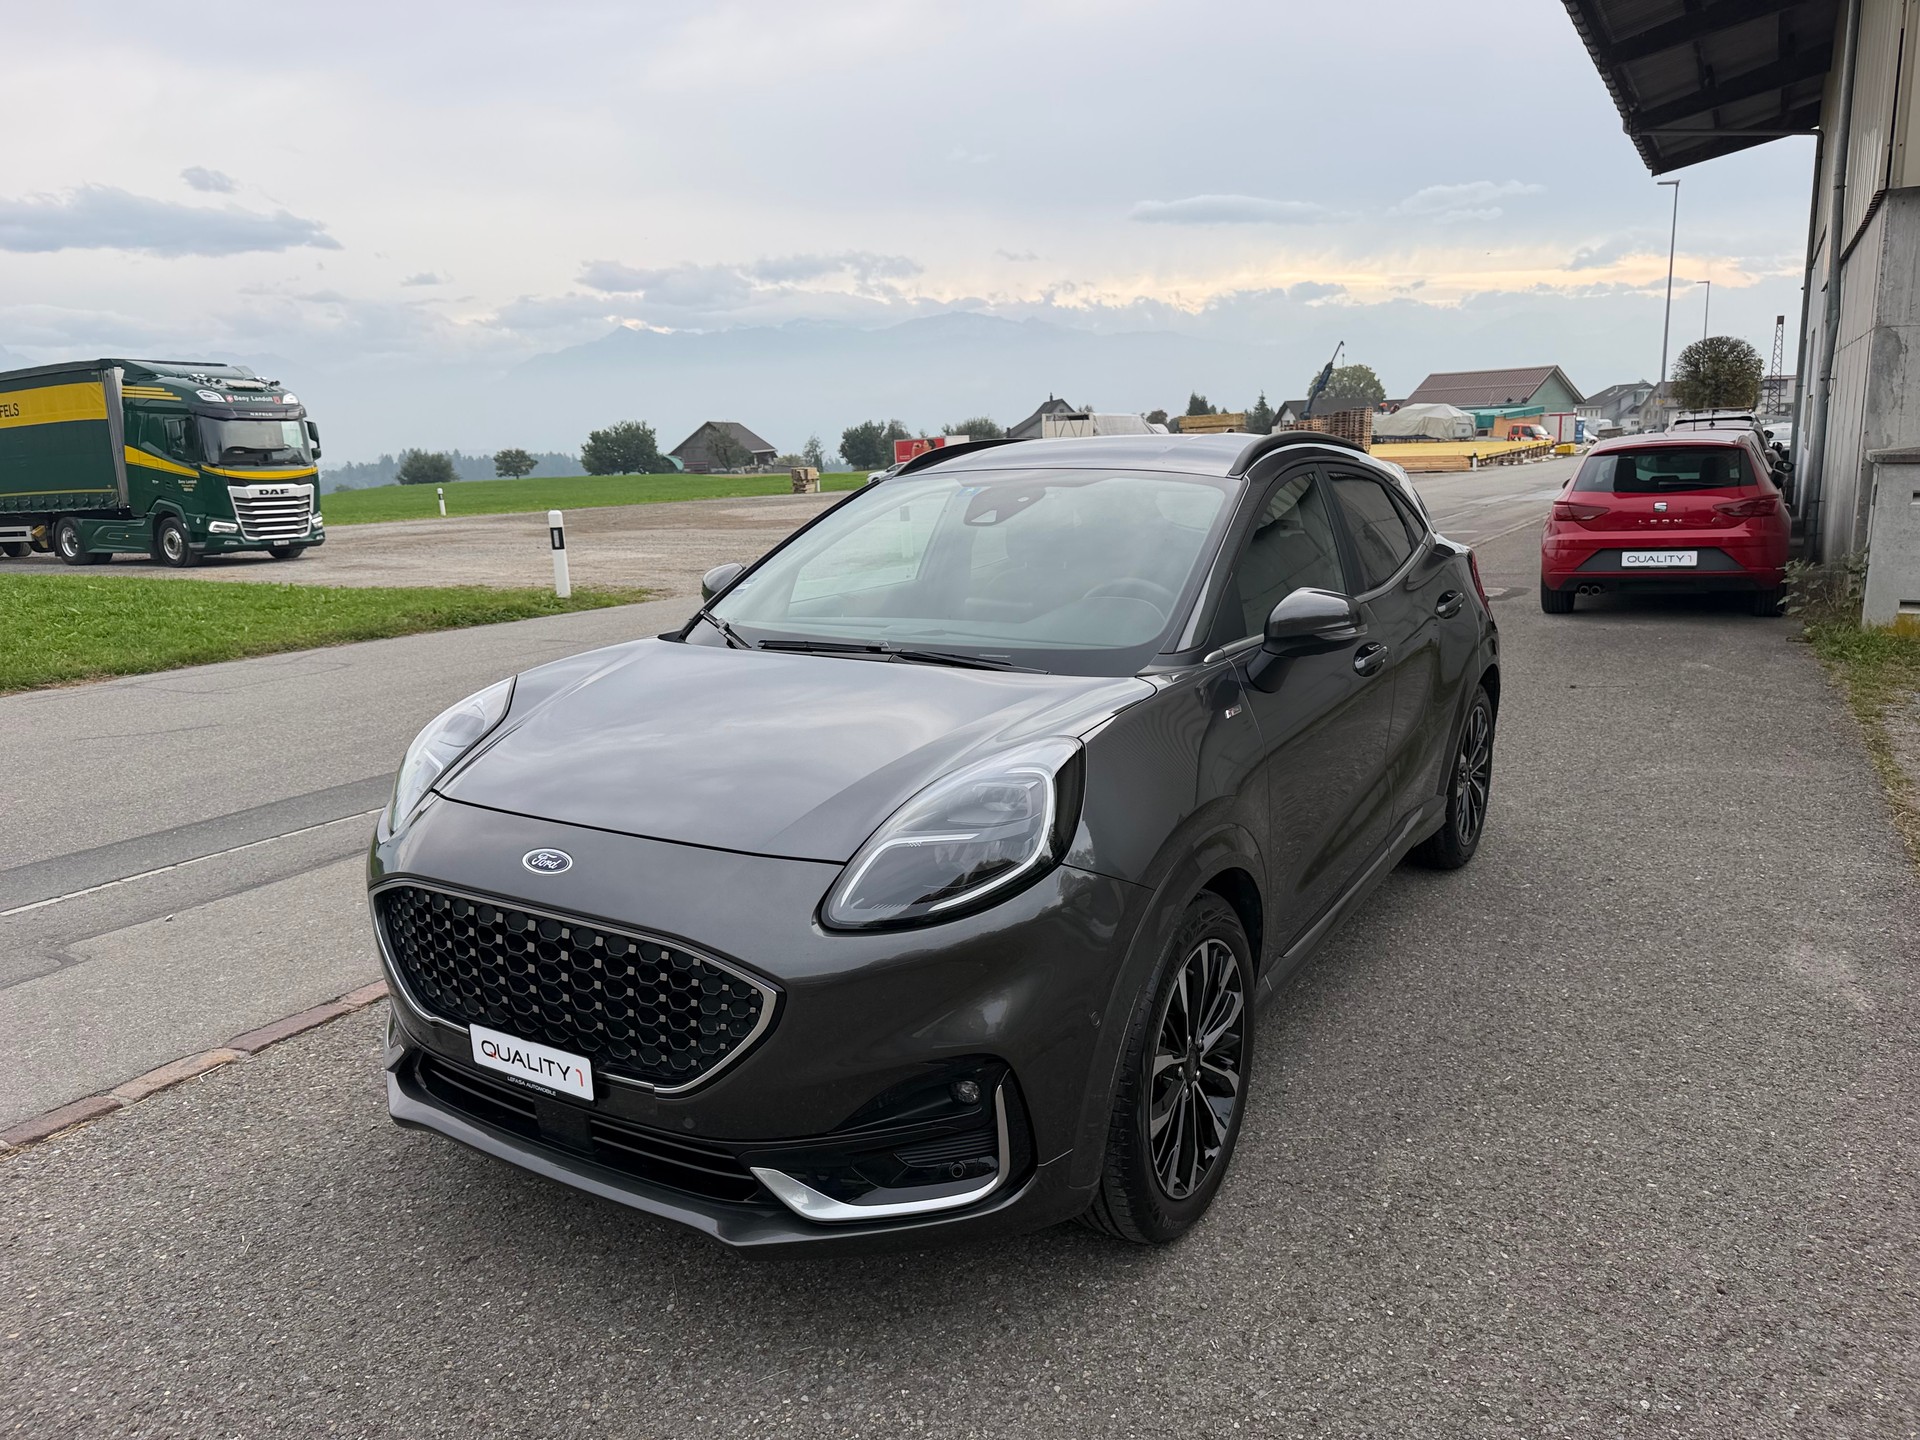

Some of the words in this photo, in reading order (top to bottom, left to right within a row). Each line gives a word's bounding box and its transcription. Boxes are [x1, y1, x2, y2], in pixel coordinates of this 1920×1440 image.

[1627, 555, 1684, 563] QUALITY
[531, 852, 562, 869] Ford
[481, 1040, 571, 1081] QUALITY
[575, 1068, 584, 1087] 1
